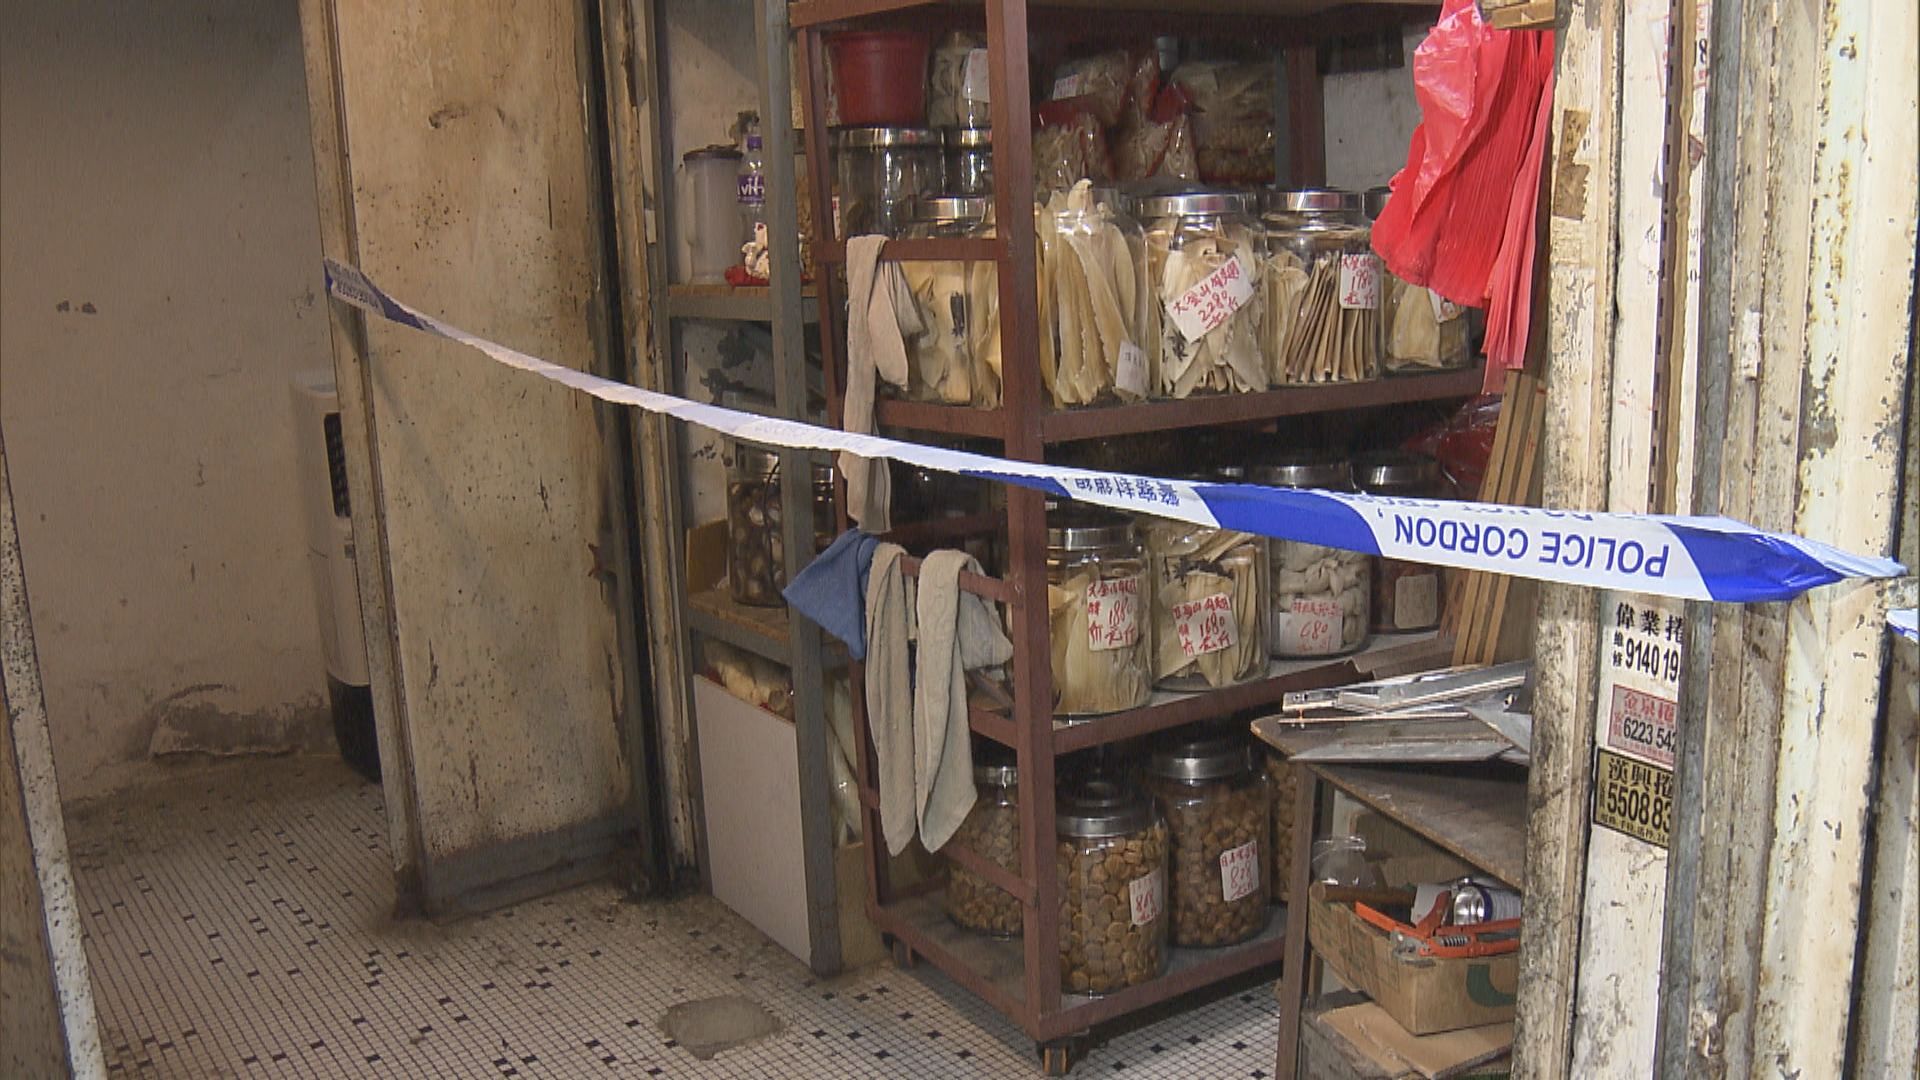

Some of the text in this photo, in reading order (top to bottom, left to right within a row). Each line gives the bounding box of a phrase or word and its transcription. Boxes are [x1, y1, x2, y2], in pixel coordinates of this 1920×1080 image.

[1200, 290, 1229, 323] 2280
[1539, 531, 1669, 578] POLICE
[1200, 611, 1225, 638] 1680
[1300, 620, 1329, 640] 680
[1625, 637, 1680, 683] 9140 19
[1623, 716, 1654, 745] 6223
[1607, 782, 1650, 825] 5508
[1652, 797, 1672, 832] 83
